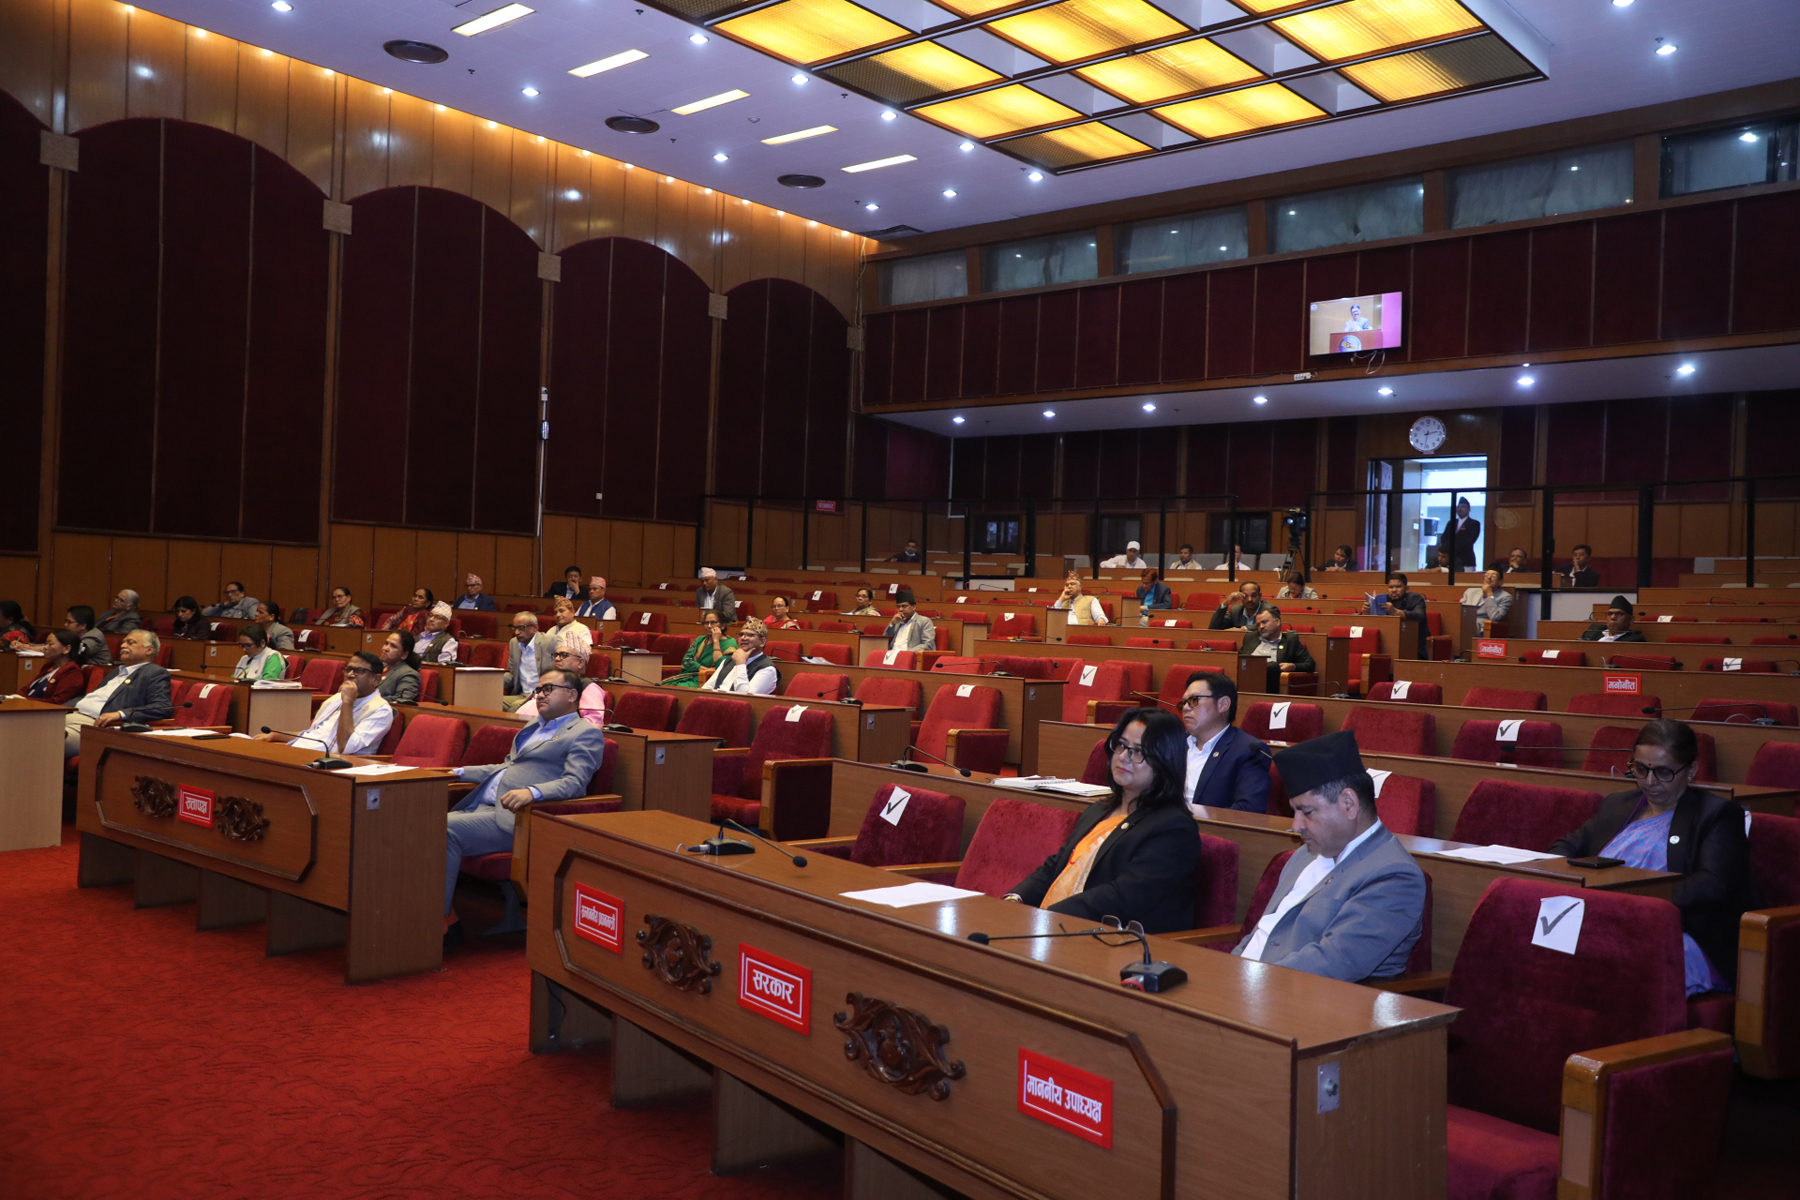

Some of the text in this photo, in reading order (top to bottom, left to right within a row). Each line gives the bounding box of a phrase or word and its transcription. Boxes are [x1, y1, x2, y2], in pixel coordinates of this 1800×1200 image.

[753, 969, 795, 1004] सरकार
[1027, 1074, 1103, 1124] माननीय उपाध्यक्ष
